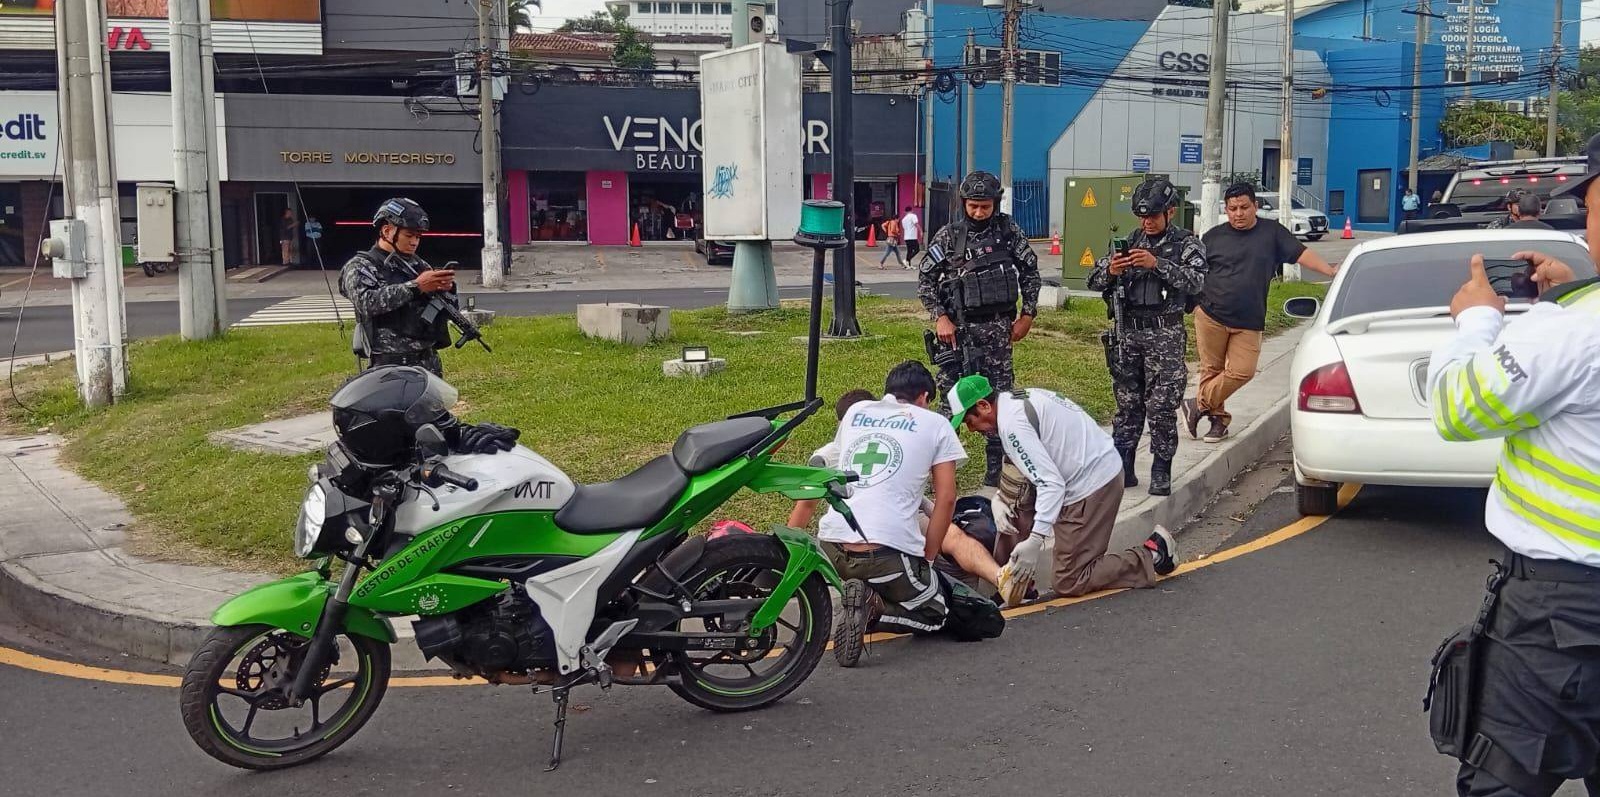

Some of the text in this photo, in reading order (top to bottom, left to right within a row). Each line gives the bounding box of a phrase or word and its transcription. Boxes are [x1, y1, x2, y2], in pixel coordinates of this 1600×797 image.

[1457, 6, 1490, 14] MEICA
[1449, 25, 1500, 33] PSICLOGÍA
[1159, 51, 1211, 73] CSS
[738, 73, 758, 87] CITY
[0, 114, 46, 140] dit
[0, 151, 46, 159] credit.sv
[280, 151, 456, 164] TORRE MONTECRISTO
[637, 154, 702, 169] BEAUT
[1493, 344, 1528, 383] MOPT
[851, 412, 918, 432] Electrolit
[356, 567, 397, 599] GESTOR
[399, 555, 413, 569] DE
